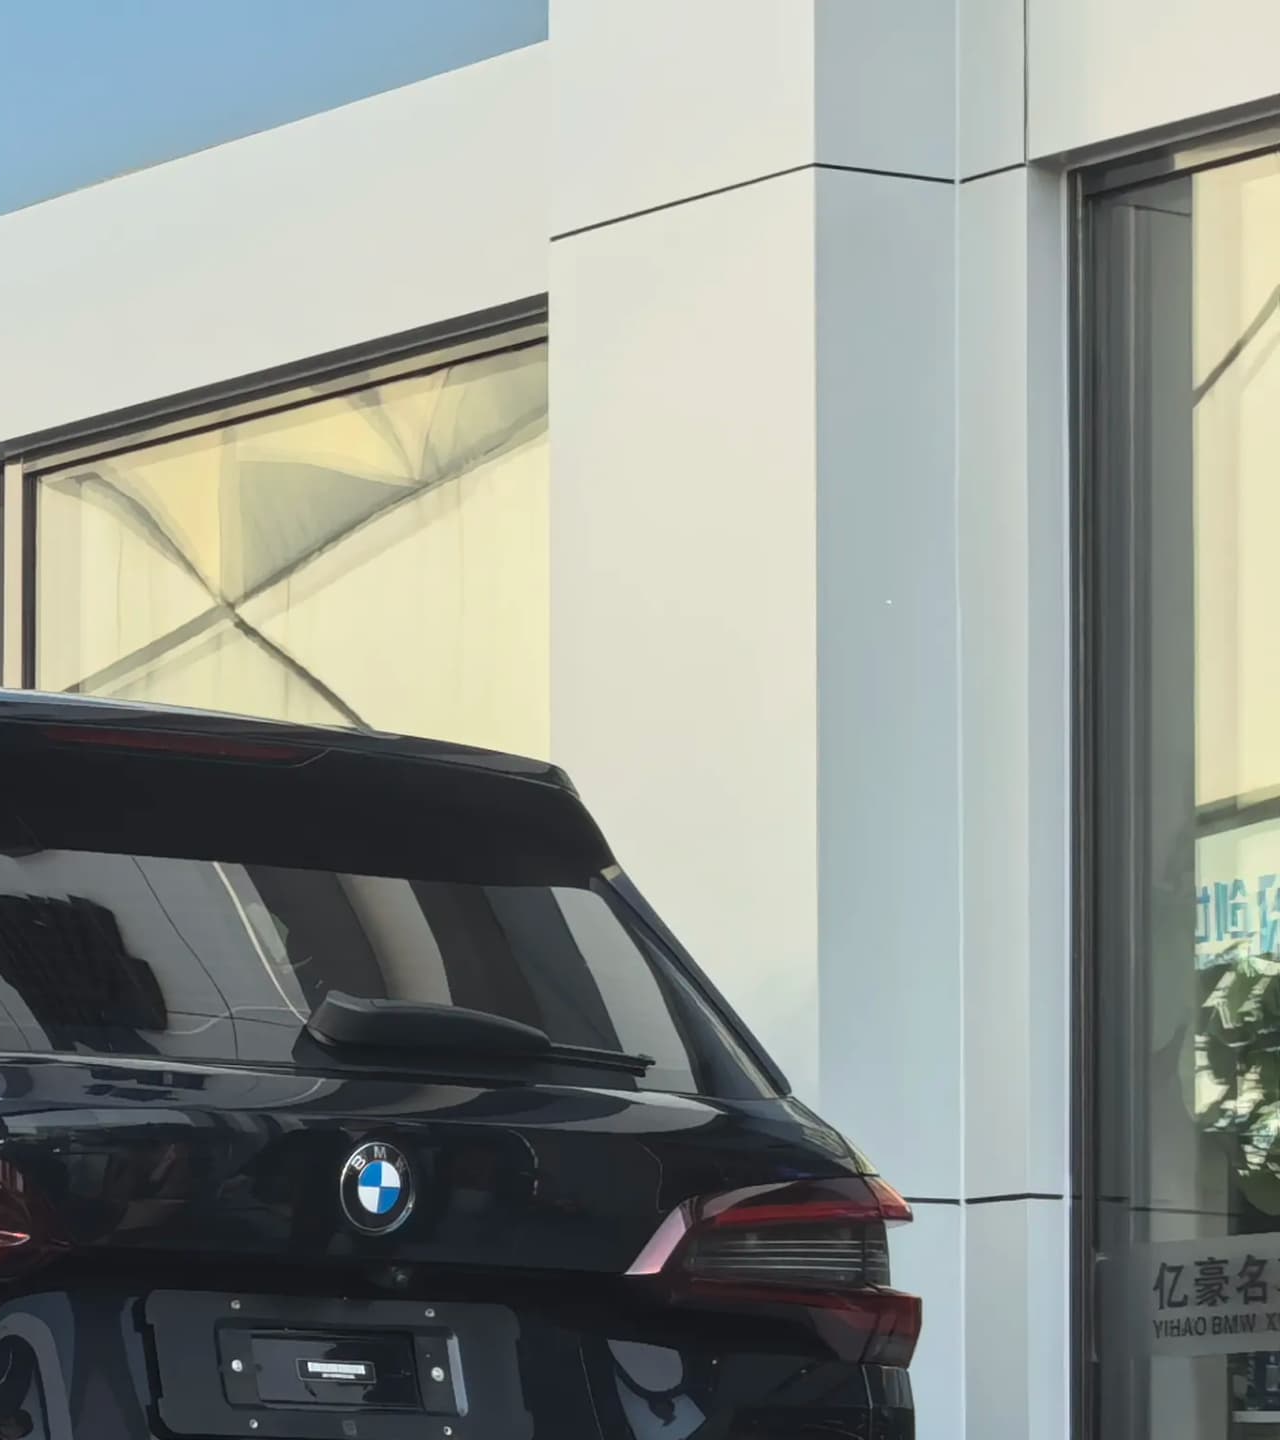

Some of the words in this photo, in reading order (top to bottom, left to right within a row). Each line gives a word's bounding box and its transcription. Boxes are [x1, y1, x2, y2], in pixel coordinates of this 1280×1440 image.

[1153, 1254, 1280, 1310] 亿豪名
[1153, 1316, 1207, 1339] YIHAO
[1212, 1314, 1256, 1335] BMW
